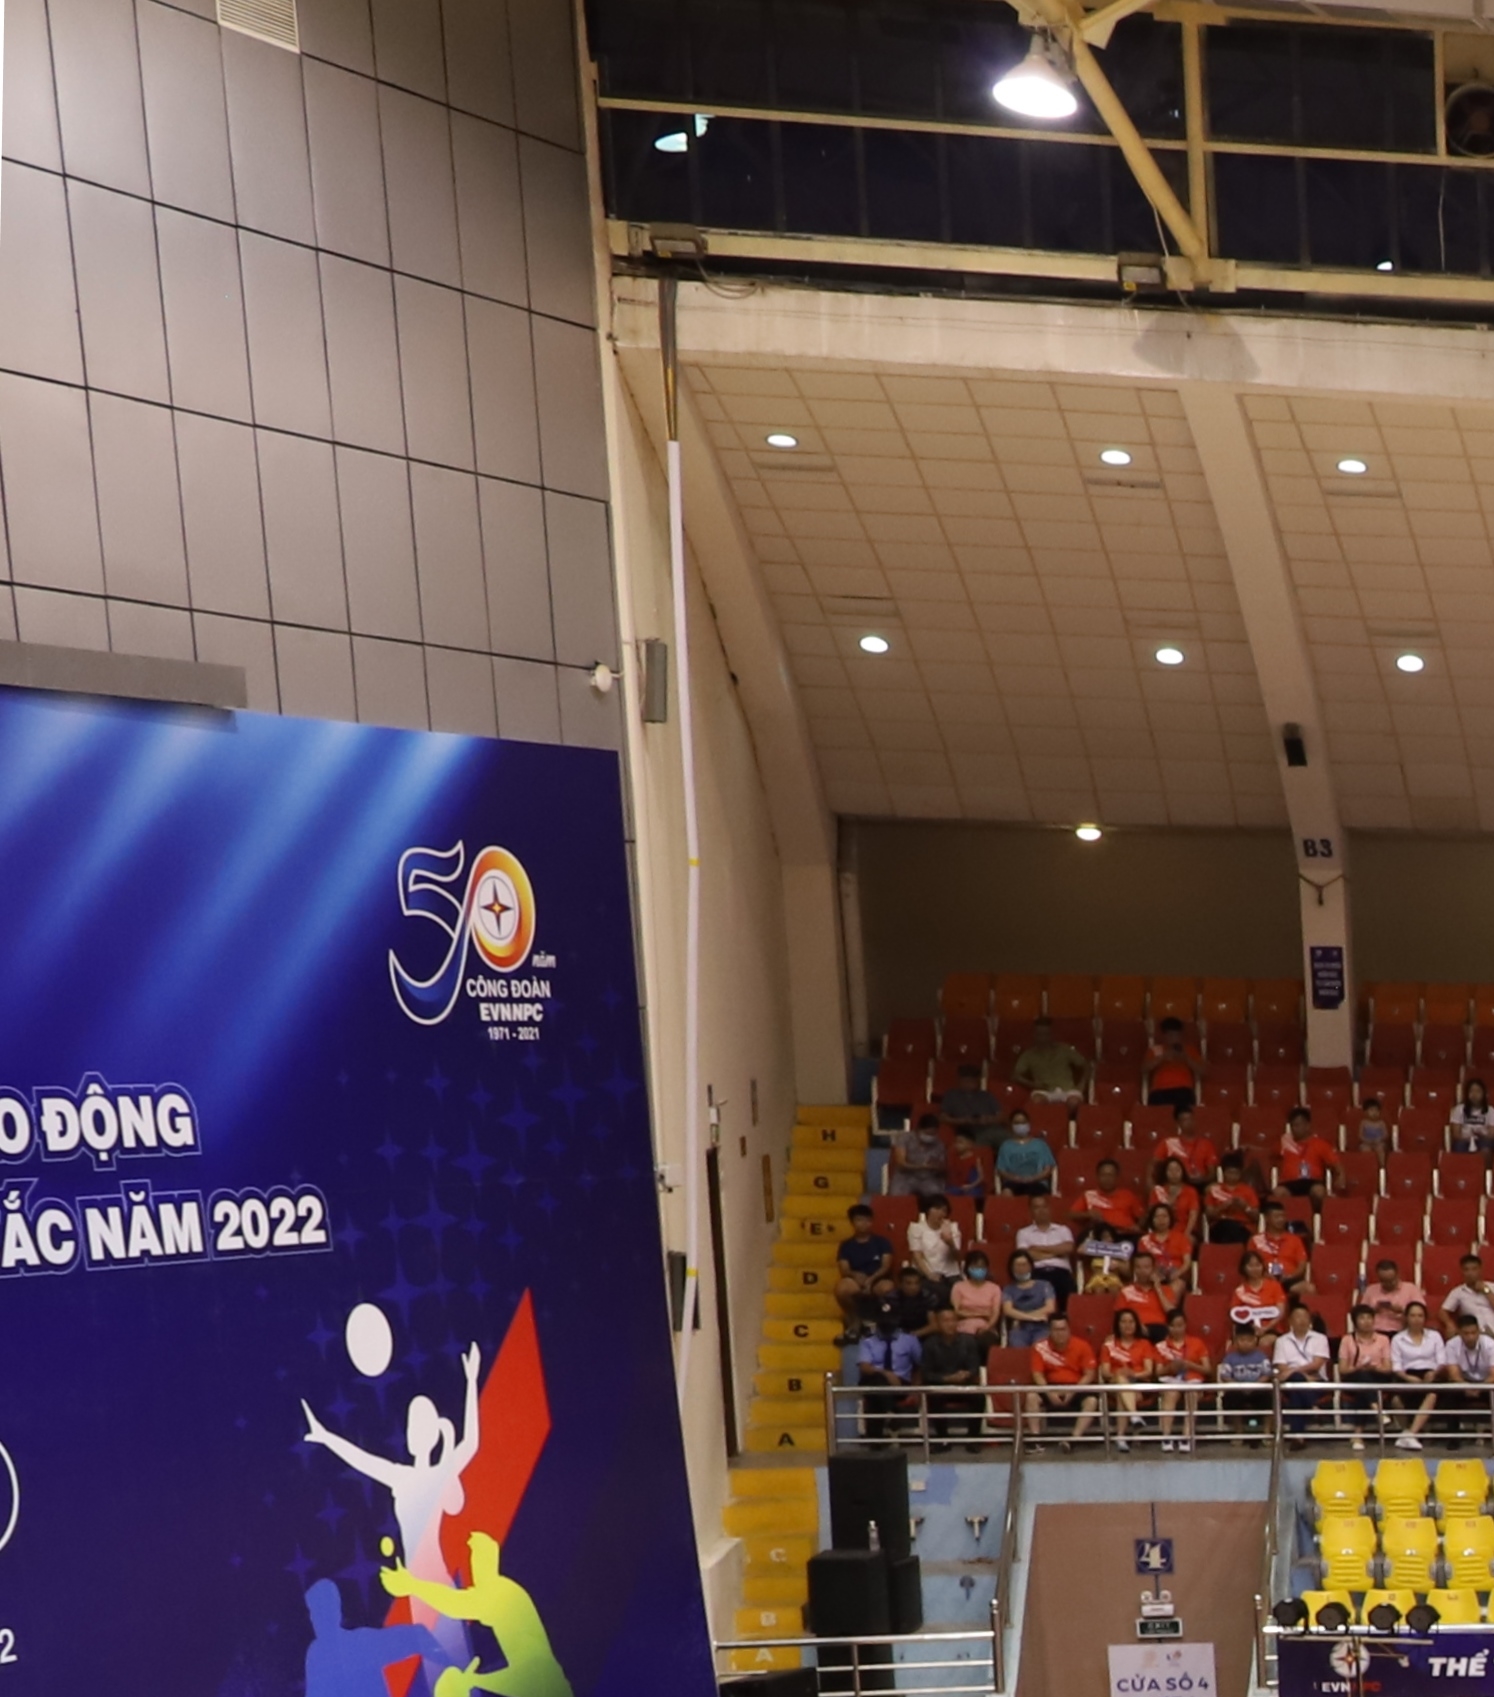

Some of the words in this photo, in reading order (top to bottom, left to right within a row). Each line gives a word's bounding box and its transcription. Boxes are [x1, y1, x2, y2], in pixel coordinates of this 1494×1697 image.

[1303, 838, 1333, 859] B3
[466, 974, 508, 998] CÔNG
[511, 975, 551, 998] ĐOÀN
[479, 1002, 544, 1022] EVNNPC
[488, 1027, 510, 1041] 1971
[518, 1027, 541, 1041] 2021
[41, 1083, 195, 1162] ĐỘNG
[822, 1129, 836, 1142] H
[85, 1190, 204, 1261] NĂM
[213, 1194, 327, 1252] 2022
[803, 1272, 818, 1285] D
[793, 1324, 809, 1338] C
[788, 1378, 802, 1392] B
[778, 1432, 795, 1446] A
[1139, 1542, 1167, 1569] 4
[1429, 1648, 1490, 1677] THỂ
[1116, 1673, 1161, 1693] CỬA
[1166, 1672, 1194, 1690] SỐ
[1198, 1679, 1209, 1690] 4
